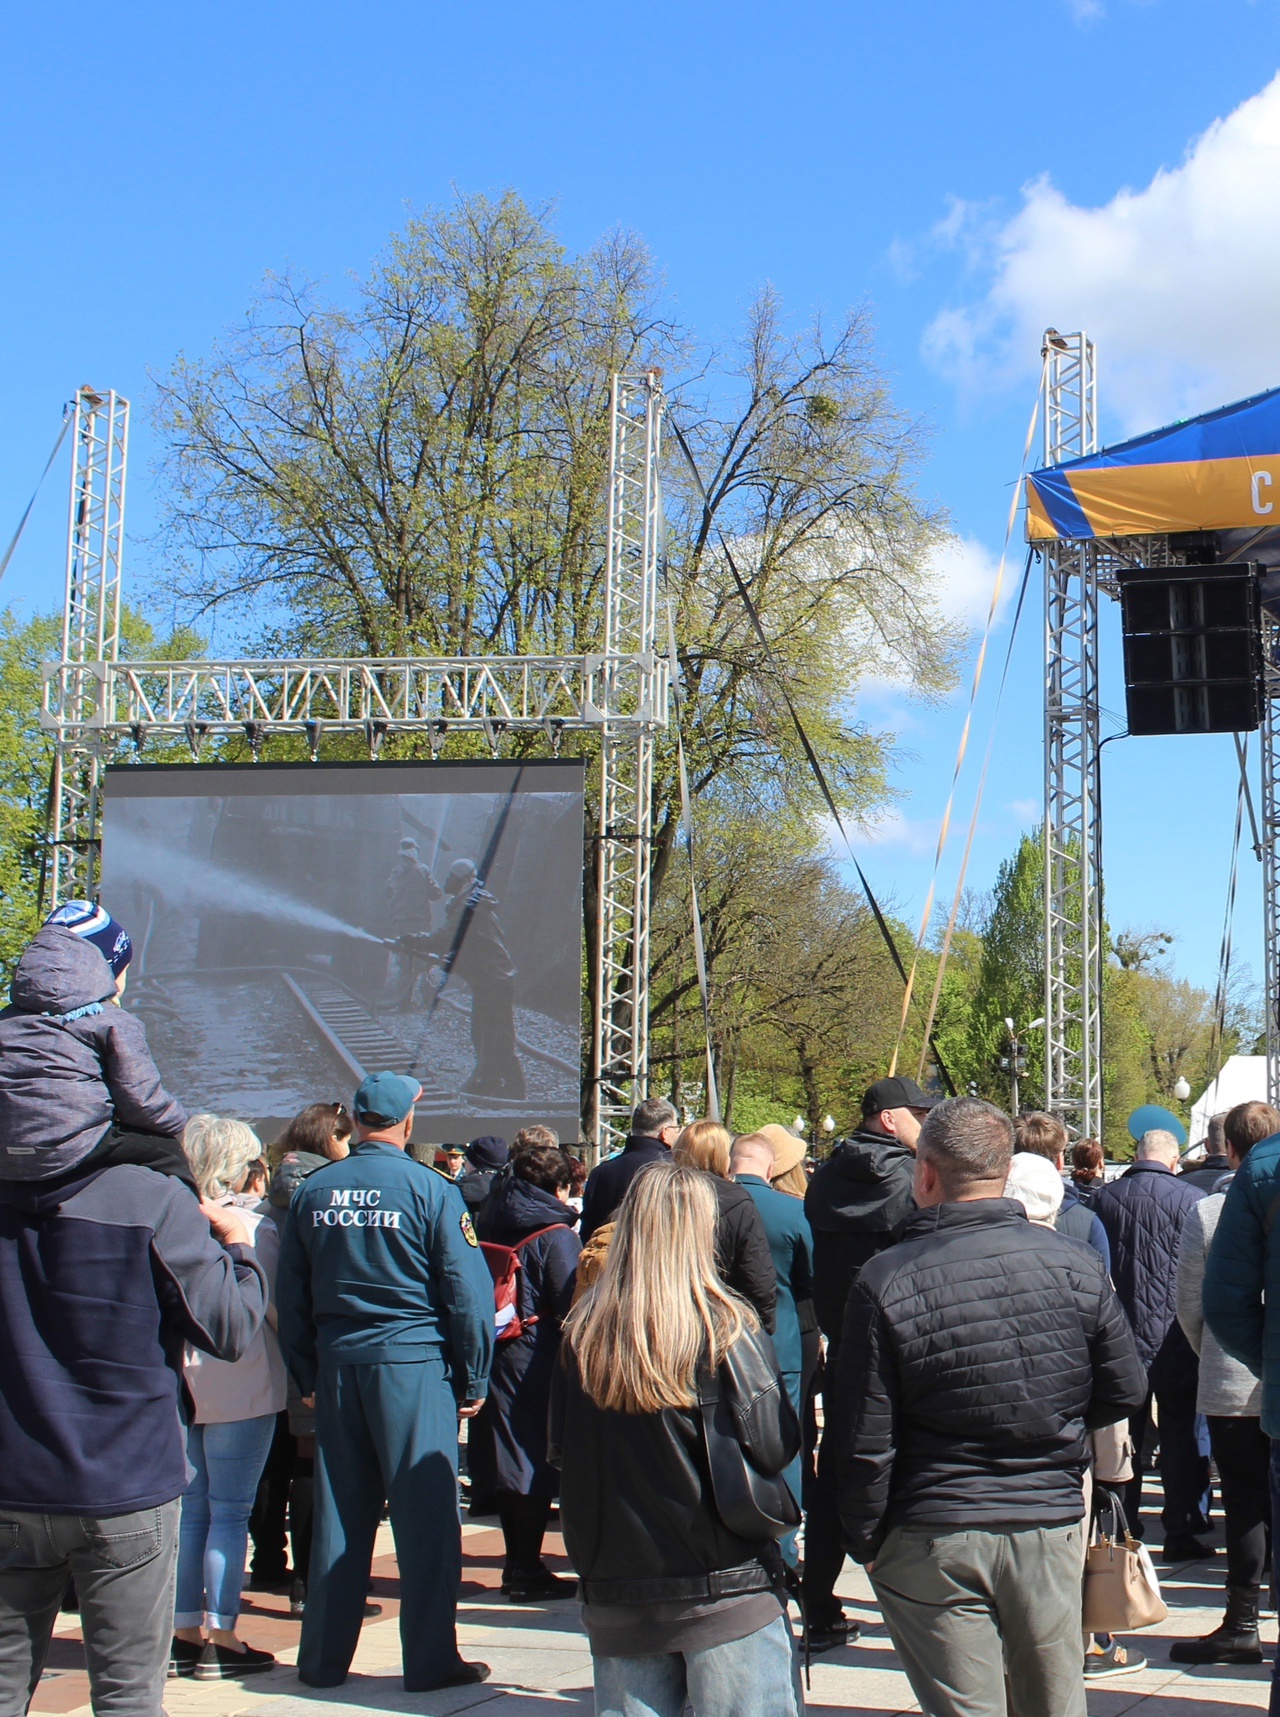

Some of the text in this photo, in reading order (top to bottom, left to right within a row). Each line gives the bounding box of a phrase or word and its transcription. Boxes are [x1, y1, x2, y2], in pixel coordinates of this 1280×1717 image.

[1250, 469, 1274, 515] С
[328, 1189, 382, 1208] МЧС
[311, 1208, 402, 1230] РОССИИ
